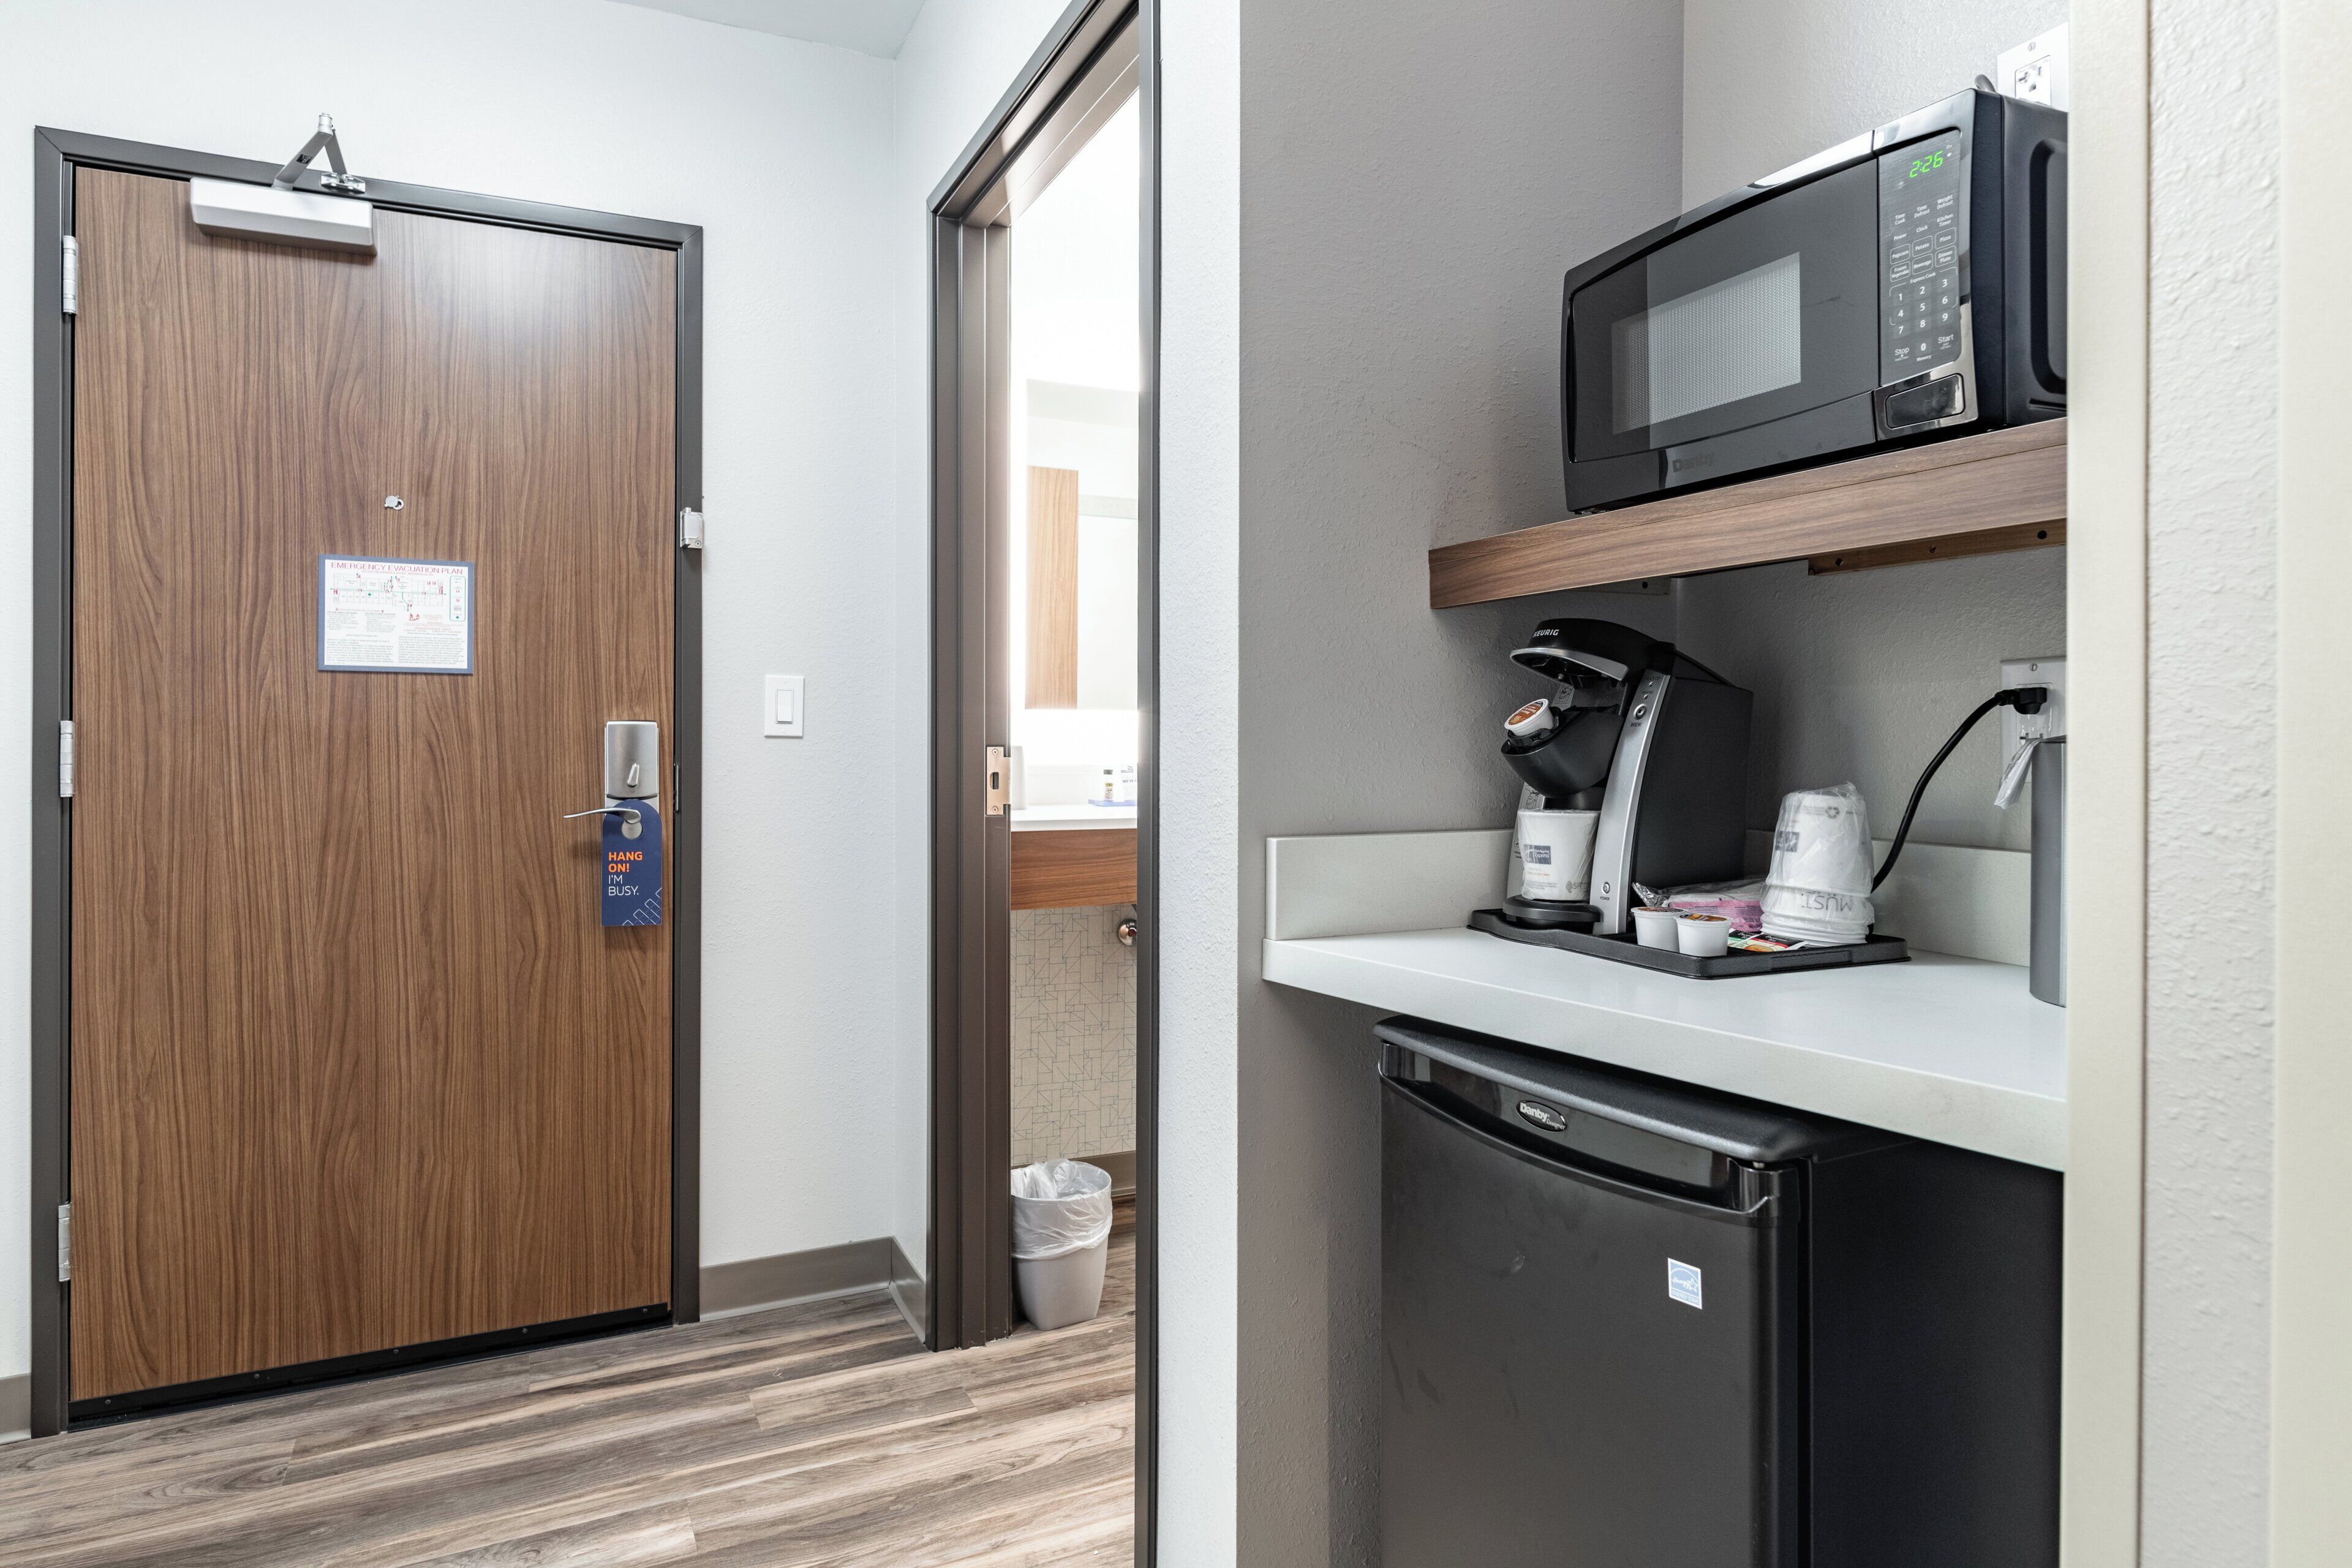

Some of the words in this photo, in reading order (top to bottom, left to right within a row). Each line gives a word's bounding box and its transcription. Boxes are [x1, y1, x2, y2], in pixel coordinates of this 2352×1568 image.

[1909, 151, 1943, 178] 2:26
[1937, 200, 1953, 209] Defrost
[1914, 209, 1930, 218] Defrost
[1937, 214, 1953, 222] Kitchen
[1892, 250, 1909, 258] Popcorn
[1938, 250, 1953, 258] Dinner
[1913, 260, 1931, 269] Beverage
[1910, 275, 1925, 284] Express
[1920, 286, 1925, 295] 2
[1920, 303, 1925, 311] 5
[1938, 334, 1954, 343] Start
[1672, 453, 1714, 472] Danby
[331, 562, 386, 571] EMERGENCY
[388, 564, 440, 574] EVACUATION
[1532, 629, 1559, 638] KEURIG
[609, 851, 643, 861] HANG
[608, 863, 630, 872] ON!
[609, 875, 623, 884] I'M
[609, 886, 639, 895] BUSY.
[1520, 1102, 1548, 1123] Danby
